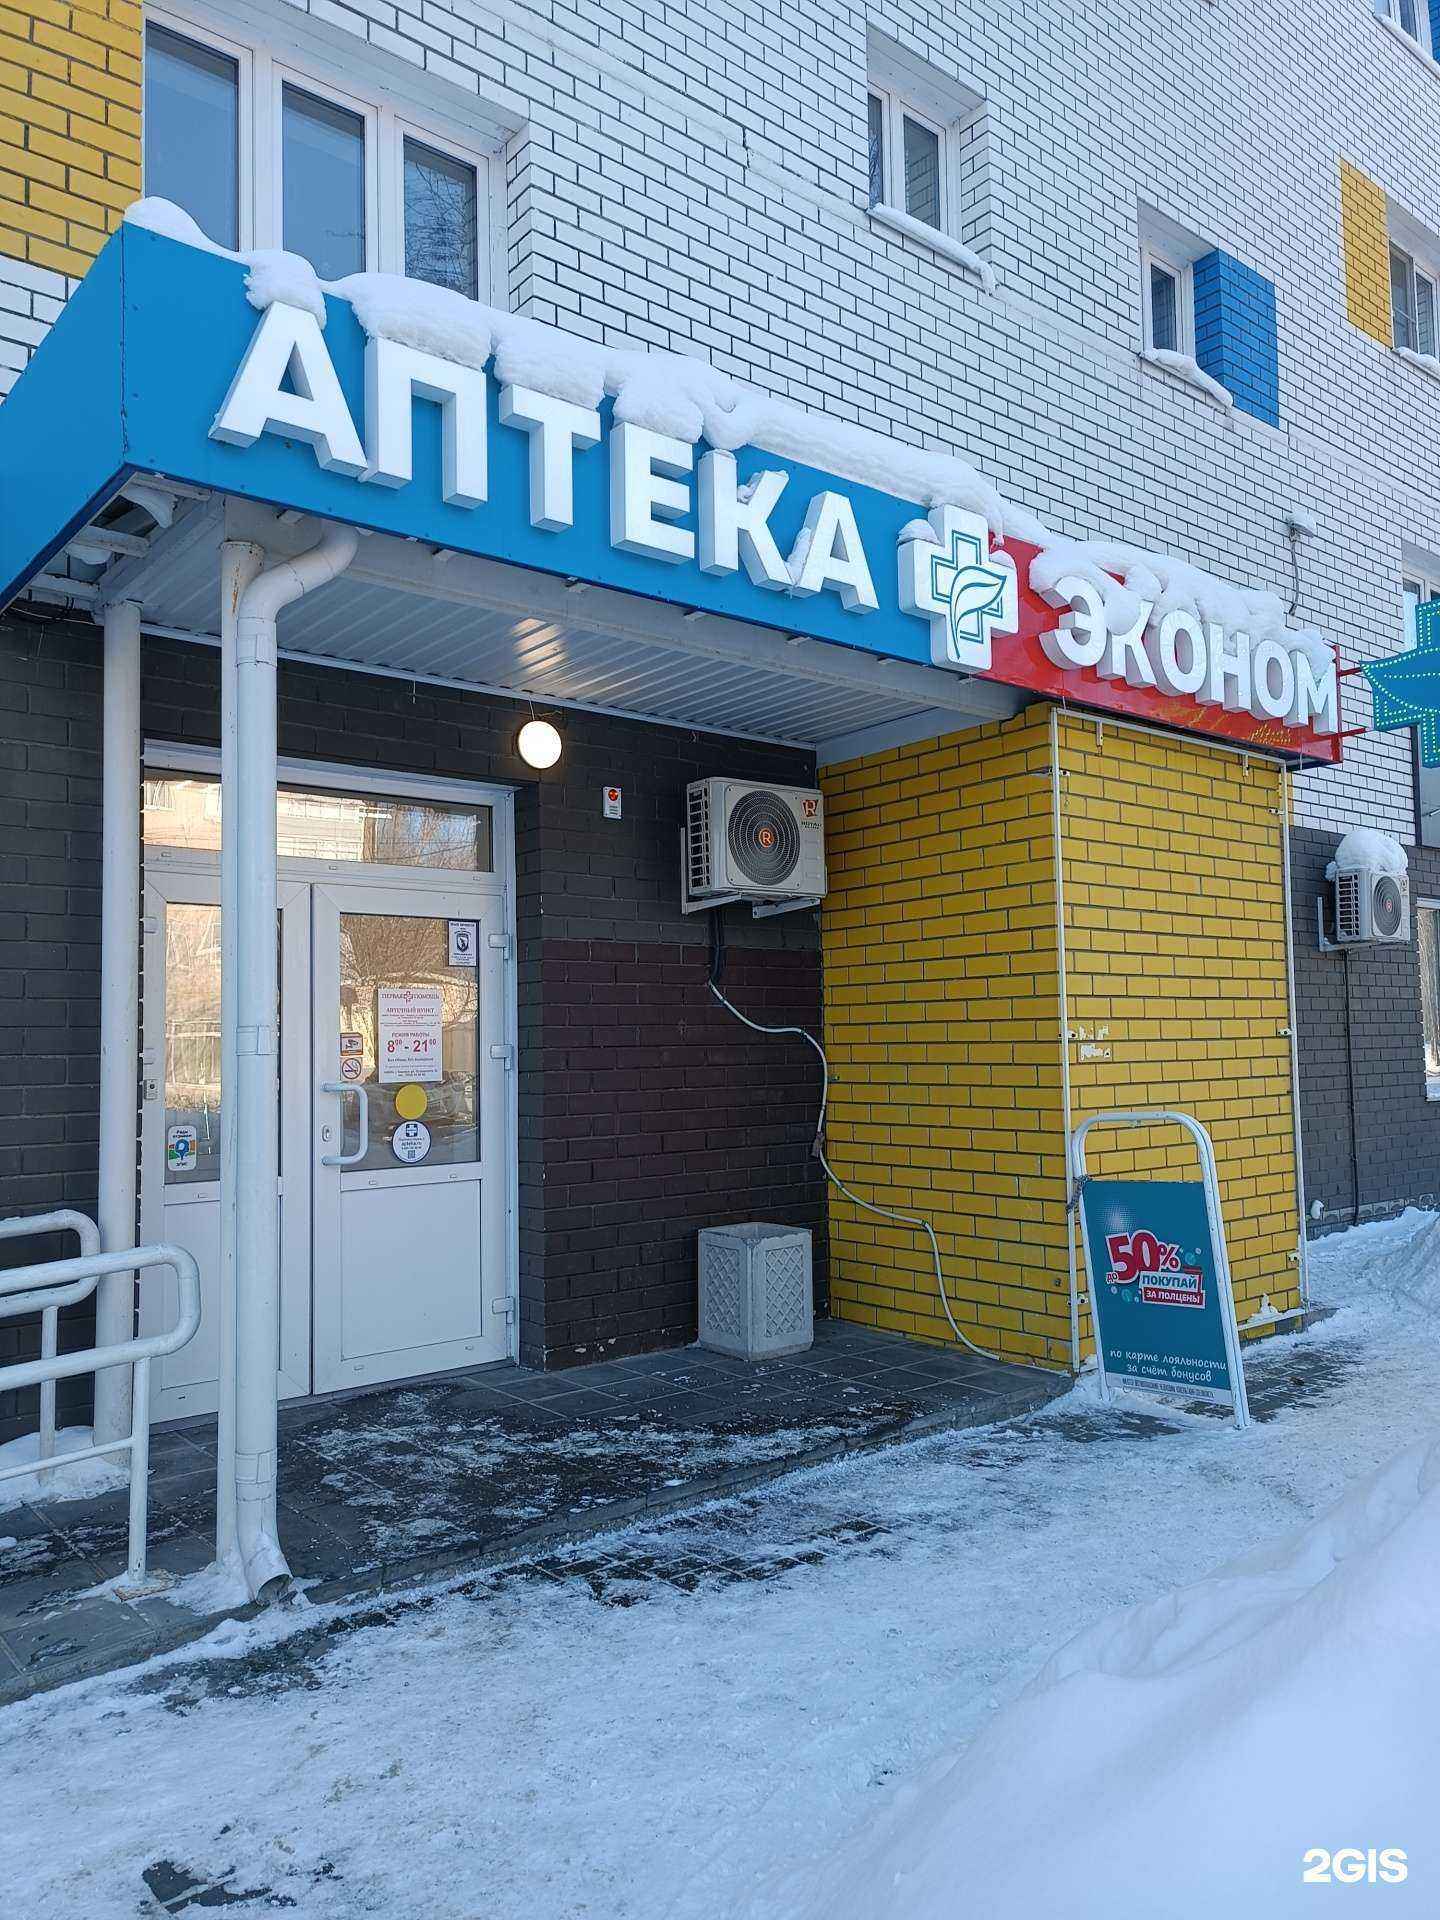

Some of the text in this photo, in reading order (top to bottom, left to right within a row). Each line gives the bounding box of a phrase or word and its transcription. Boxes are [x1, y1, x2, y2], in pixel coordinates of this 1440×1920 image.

[208, 300, 879, 614] АПТЕКА
[1038, 575, 1338, 735] ЭКОНОМ
[1106, 1230, 1181, 1283] 50%
[1142, 1275, 1197, 1289] ПОКУПАЙ
[1146, 1290, 1200, 1303] ЗА ПОЛЦЕНЫ
[1110, 1349, 1227, 1371] по карте лояльности
[1127, 1364, 1138, 1373] за
[1171, 1366, 1213, 1382] бонусов
